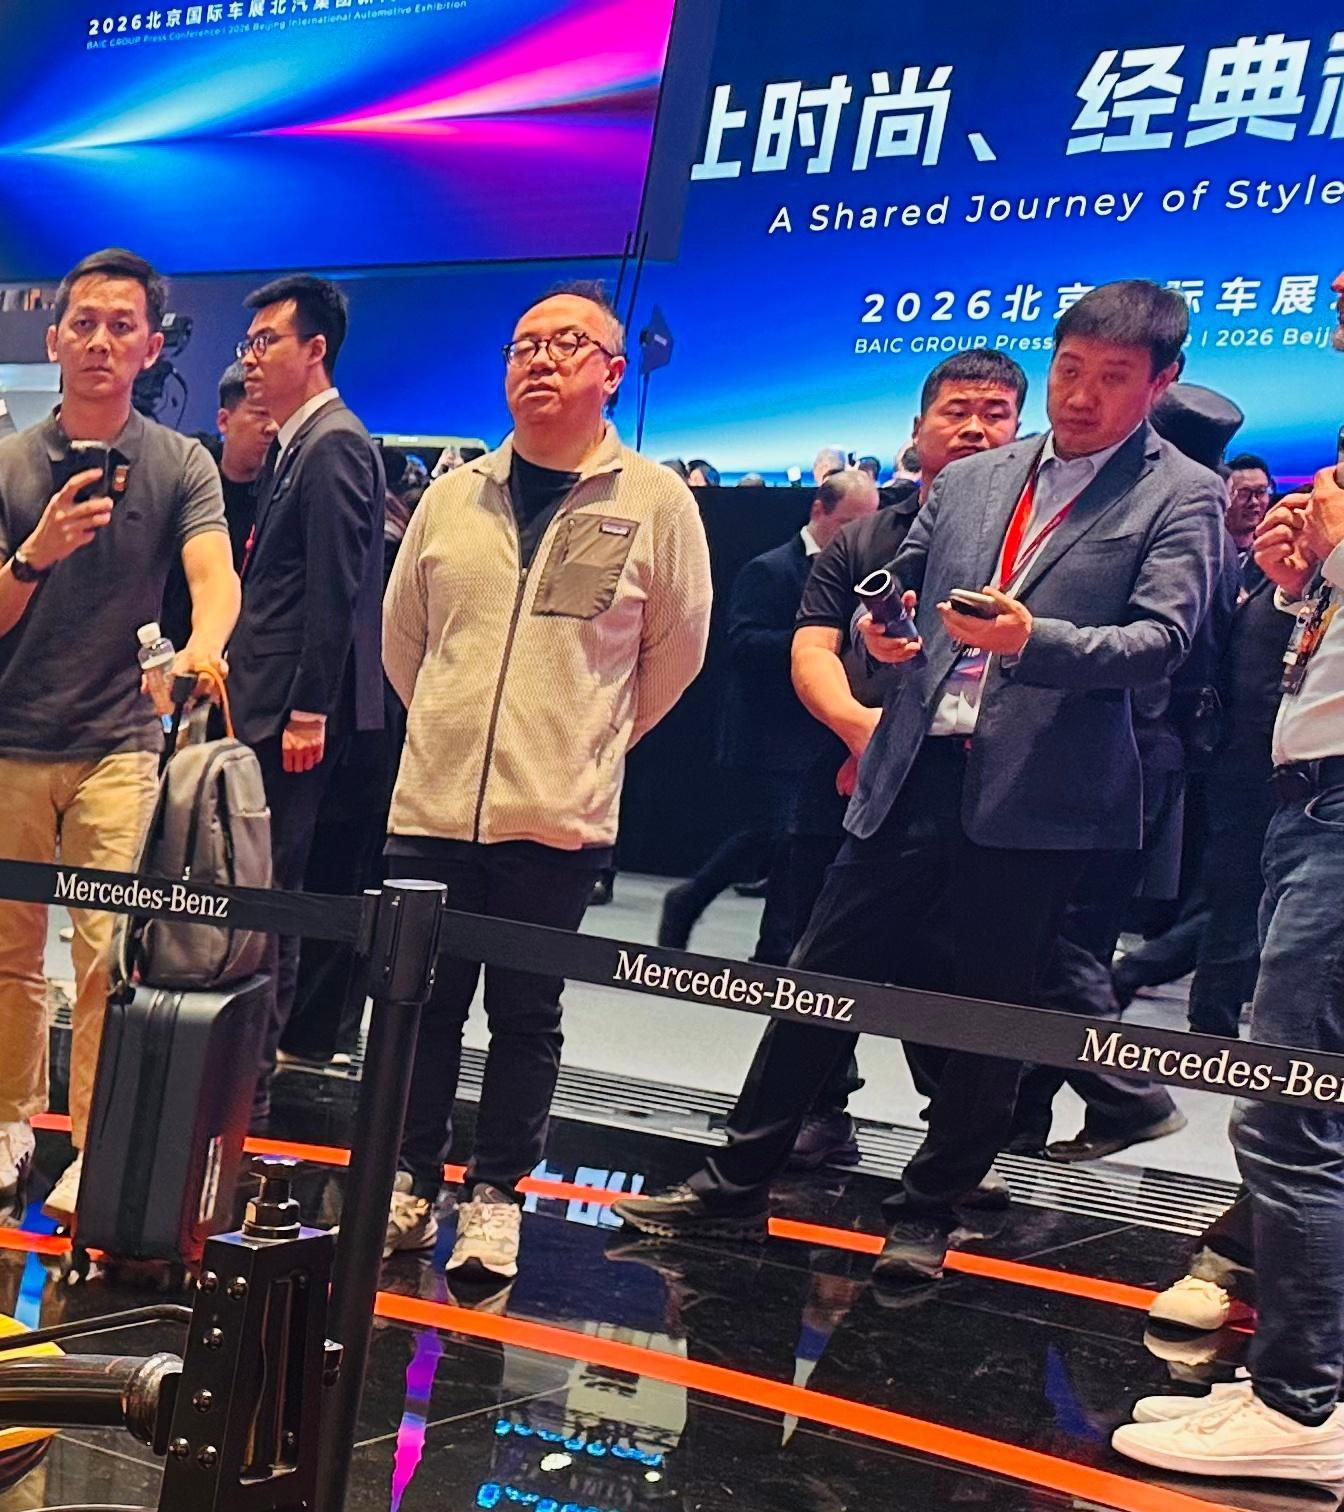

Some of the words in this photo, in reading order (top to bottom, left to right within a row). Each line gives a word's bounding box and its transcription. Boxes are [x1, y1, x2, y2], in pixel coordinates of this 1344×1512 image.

[109, 36, 141, 47] GROUP
[143, 33, 167, 43] Press
[169, 29, 221, 41] Conference
[228, 24, 250, 35] 2026
[253, 20, 286, 32] Beijing
[288, 14, 351, 27] International
[353, 6, 412, 20] Automotive
[414, 1, 468, 14] Exhibition
[769, 207, 793, 234] A
[809, 196, 949, 232] Shared
[965, 188, 1143, 224] Journey
[1161, 181, 1210, 213] of
[1226, 174, 1344, 214] Style
[855, 337, 904, 354] BAIC
[911, 335, 987, 353] GROUP
[994, 335, 1054, 351] Press
[1216, 328, 1273, 347] 2026
[1284, 327, 1332, 348] Beij
[54, 870, 229, 919] Mercedes-Benz
[613, 950, 856, 1023] Mercedes-Benz
[1077, 1027, 1344, 1104] Mercedes-Be
